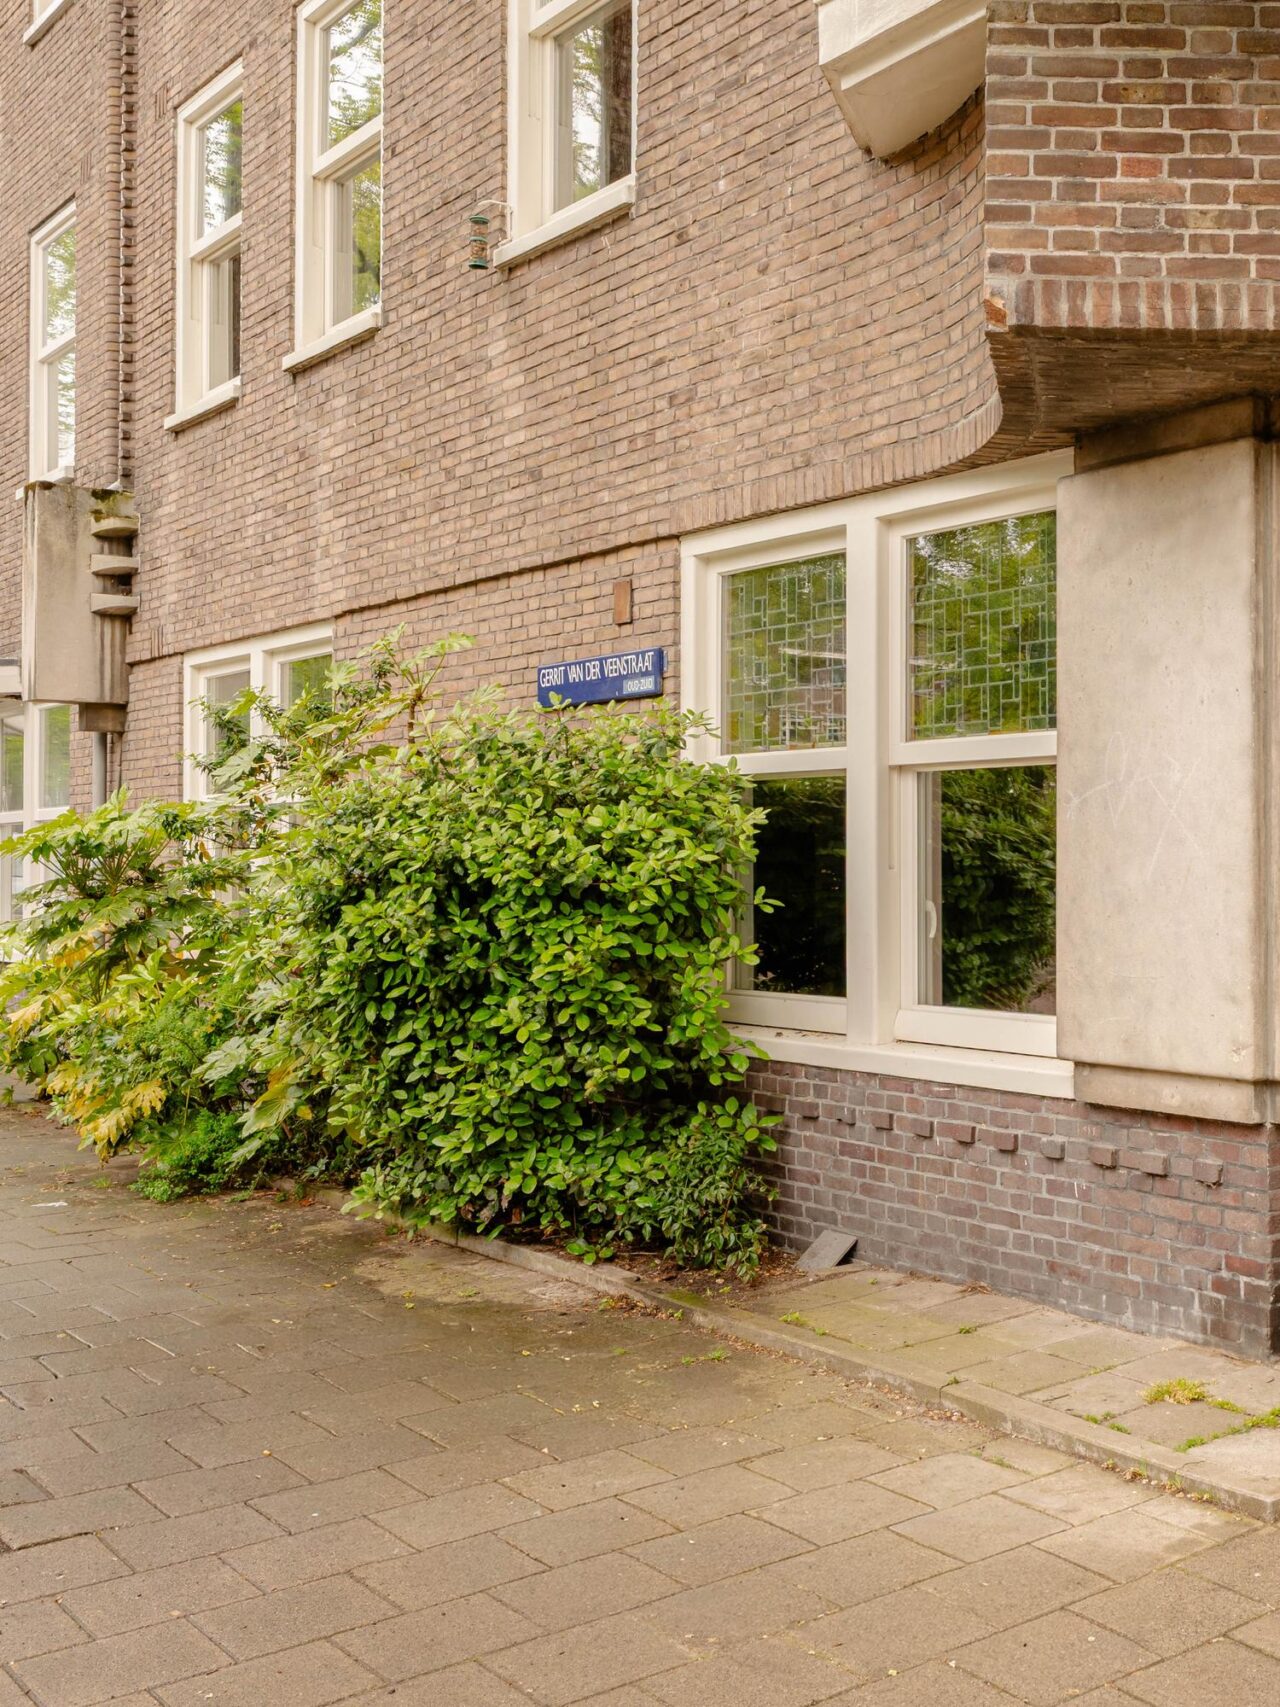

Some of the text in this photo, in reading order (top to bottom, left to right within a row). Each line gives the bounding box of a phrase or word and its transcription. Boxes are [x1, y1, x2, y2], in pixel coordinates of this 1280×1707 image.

[540, 652, 654, 687] GERRIT VAN DER VEENSTRAAT
[627, 678, 653, 692] OUD-ZUID
